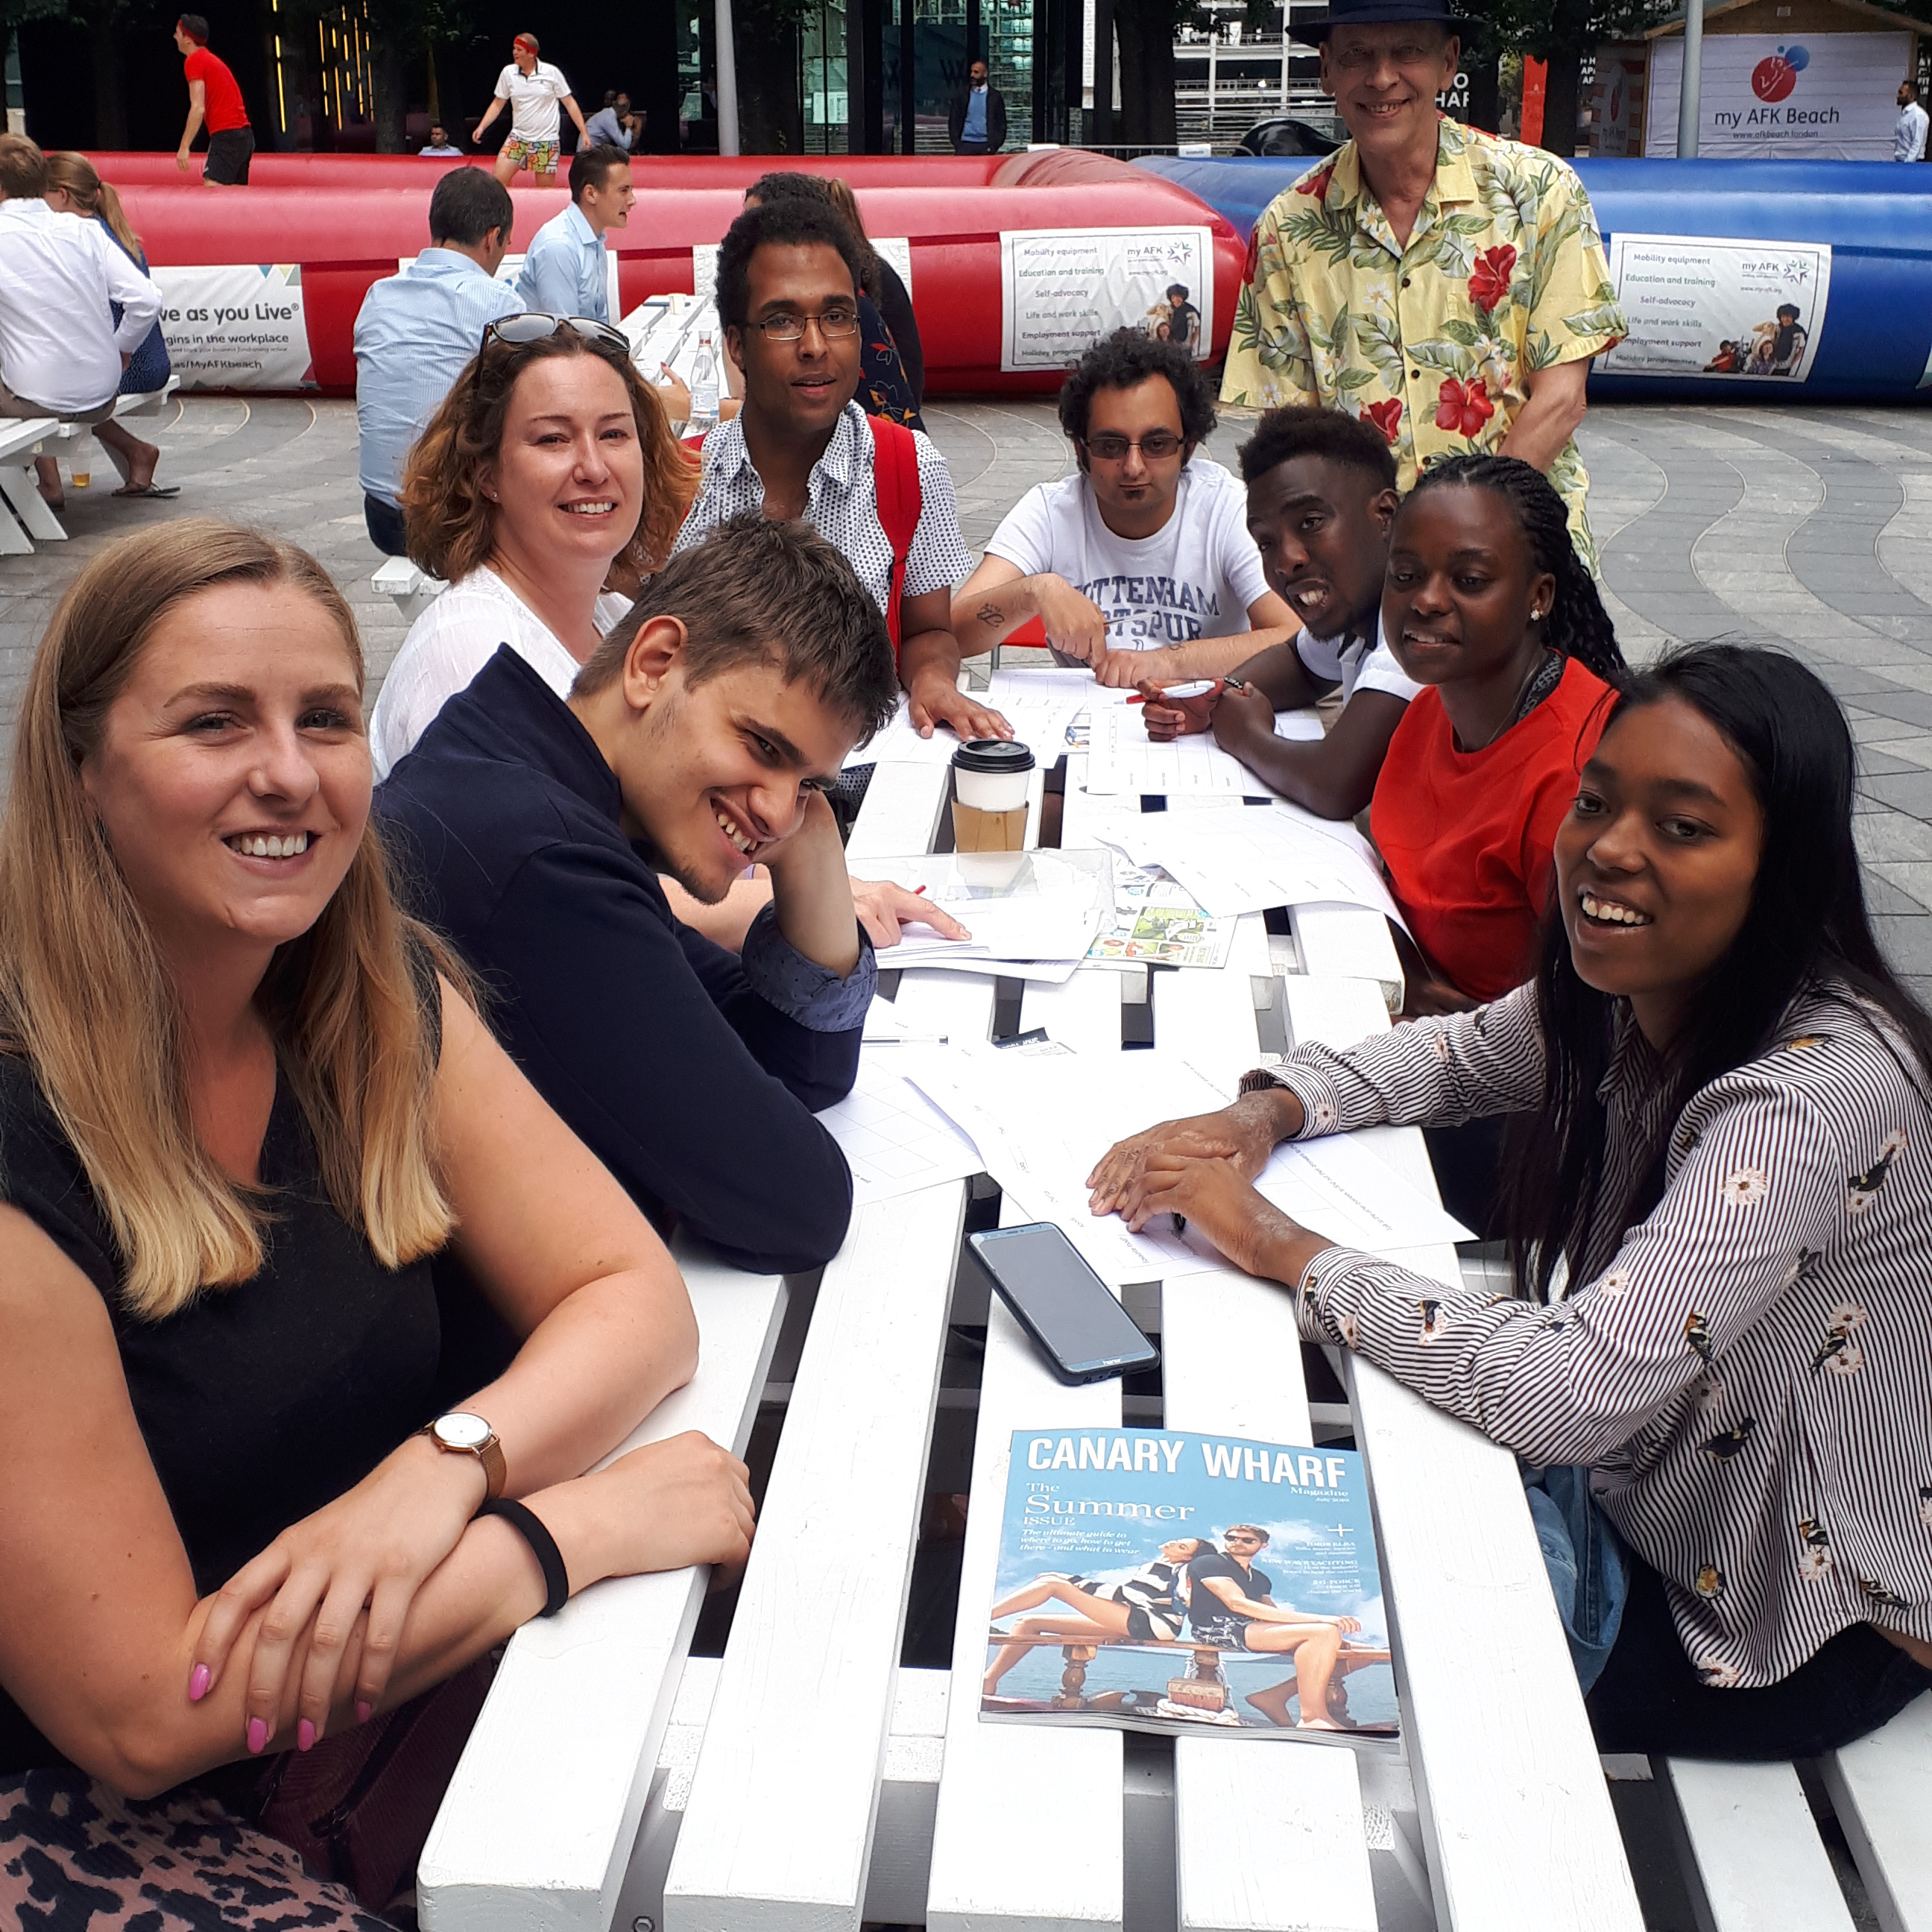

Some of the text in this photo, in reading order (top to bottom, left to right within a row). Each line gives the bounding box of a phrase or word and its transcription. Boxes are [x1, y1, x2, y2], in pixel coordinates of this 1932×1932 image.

[1715, 107, 1840, 129] my AFK Beach
[1024, 247, 1098, 257] Mobility equipment
[1127, 249, 1141, 257] my
[1634, 253, 1711, 266] Mobility equipment
[1019, 269, 1057, 277] Education
[1074, 267, 1104, 277] training
[1742, 262, 1779, 272] my AFK
[1625, 274, 1716, 288] Education and training
[1035, 289, 1089, 298] Self-advocacy
[1640, 296, 1696, 308] Self-advocacy
[158, 308, 180, 321] ve
[186, 308, 209, 321] as
[214, 307, 249, 325] you
[1026, 311, 1040, 319] Life
[1058, 310, 1076, 318] work
[1079, 309, 1098, 318] skills
[1627, 316, 1642, 325] Life
[1661, 318, 1680, 327] work
[1682, 319, 1702, 328] skills
[165, 333, 289, 345] gins in the workplace
[1022, 329, 1101, 340] Employment support
[1625, 337, 1702, 348] mployment support
[1022, 349, 1050, 358] Holiday
[1073, 575, 1219, 616] OTTENHAM
[1027, 1437, 1346, 1489] CANARY WHARF
[1026, 1483, 1060, 1492] The
[1290, 1487, 1349, 1497] Magazine
[1025, 1494, 1195, 1521] Summer
[1023, 1516, 1076, 1526] ISSUE
